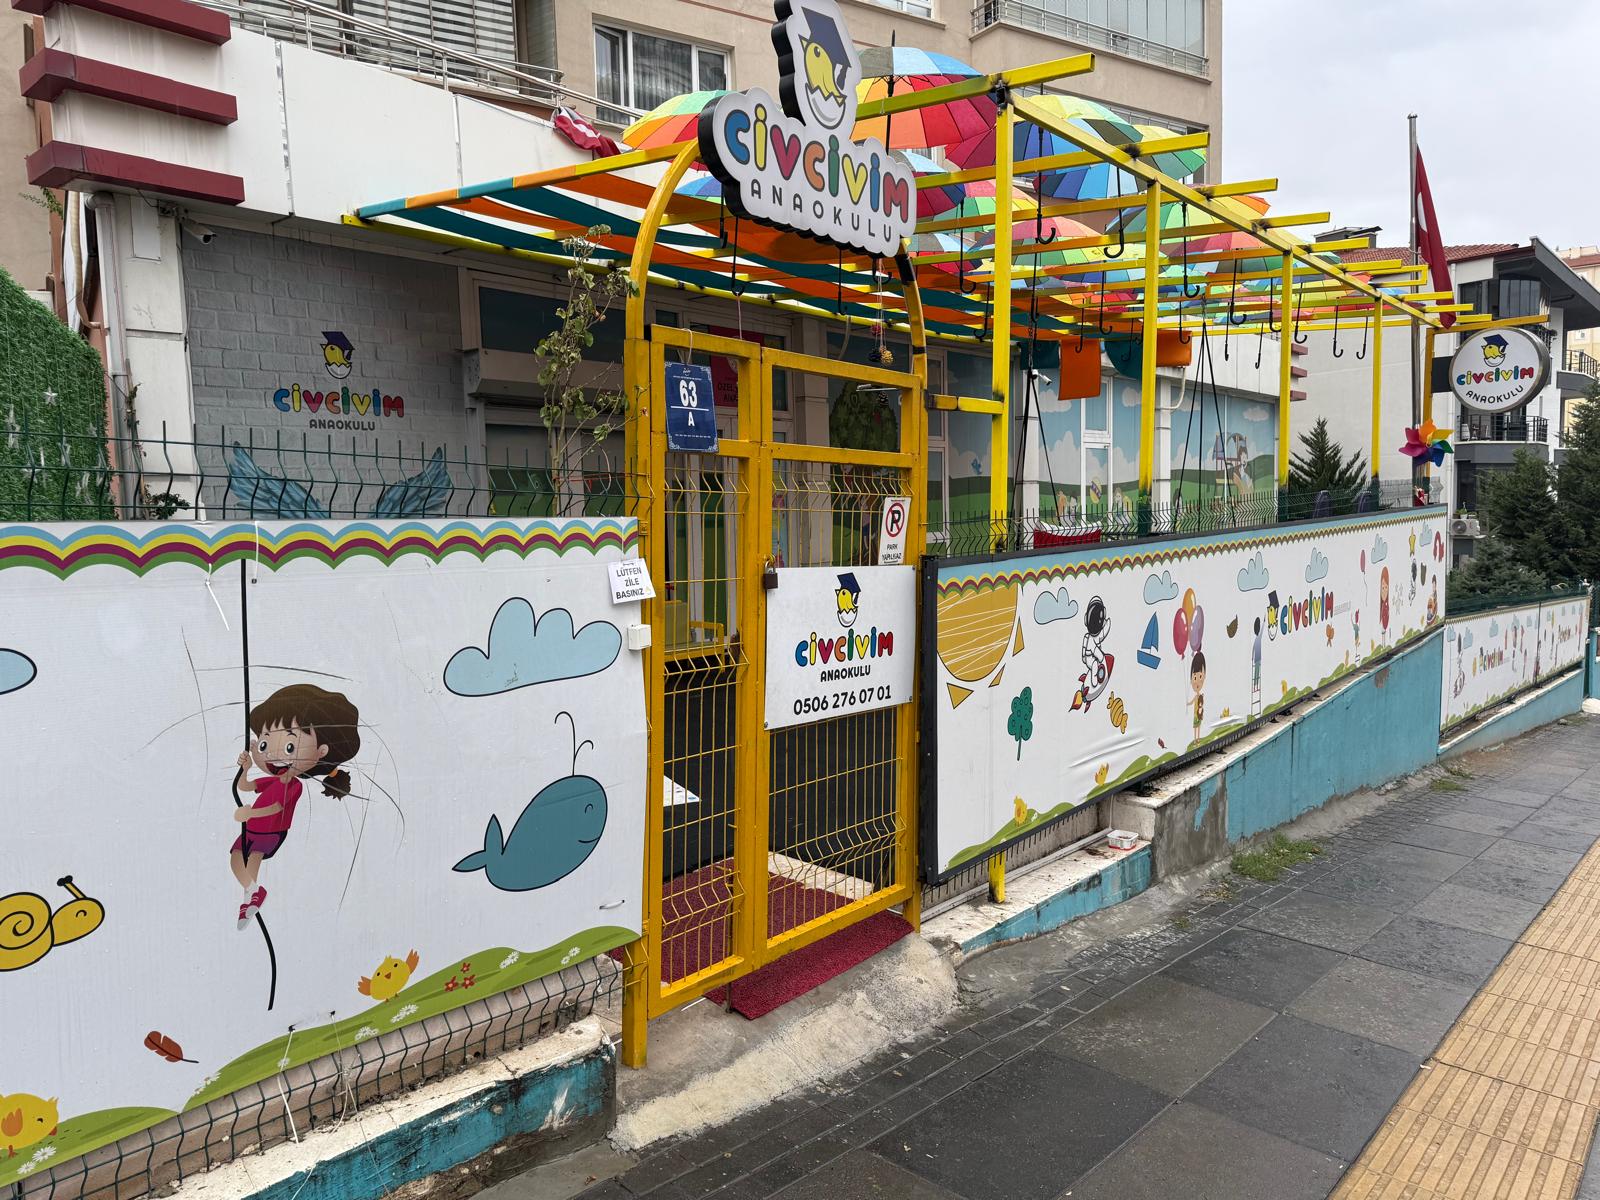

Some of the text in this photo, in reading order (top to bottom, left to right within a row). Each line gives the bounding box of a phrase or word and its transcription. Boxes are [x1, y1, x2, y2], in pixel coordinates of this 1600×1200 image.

[751, 179, 892, 242] ANAOKULU
[679, 379, 698, 408] 63
[1466, 384, 1524, 404] ANAOKULU
[309, 419, 376, 431] ANAOKULU
[688, 411, 695, 427] A
[886, 543, 898, 551] PARK
[616, 566, 642, 577] LÜTFEN
[625, 577, 640, 587] ZİLE
[615, 587, 645, 600] BASINIZ
[820, 664, 871, 683] ANAOKULU
[793, 684, 892, 716] 0506 276 07 01
